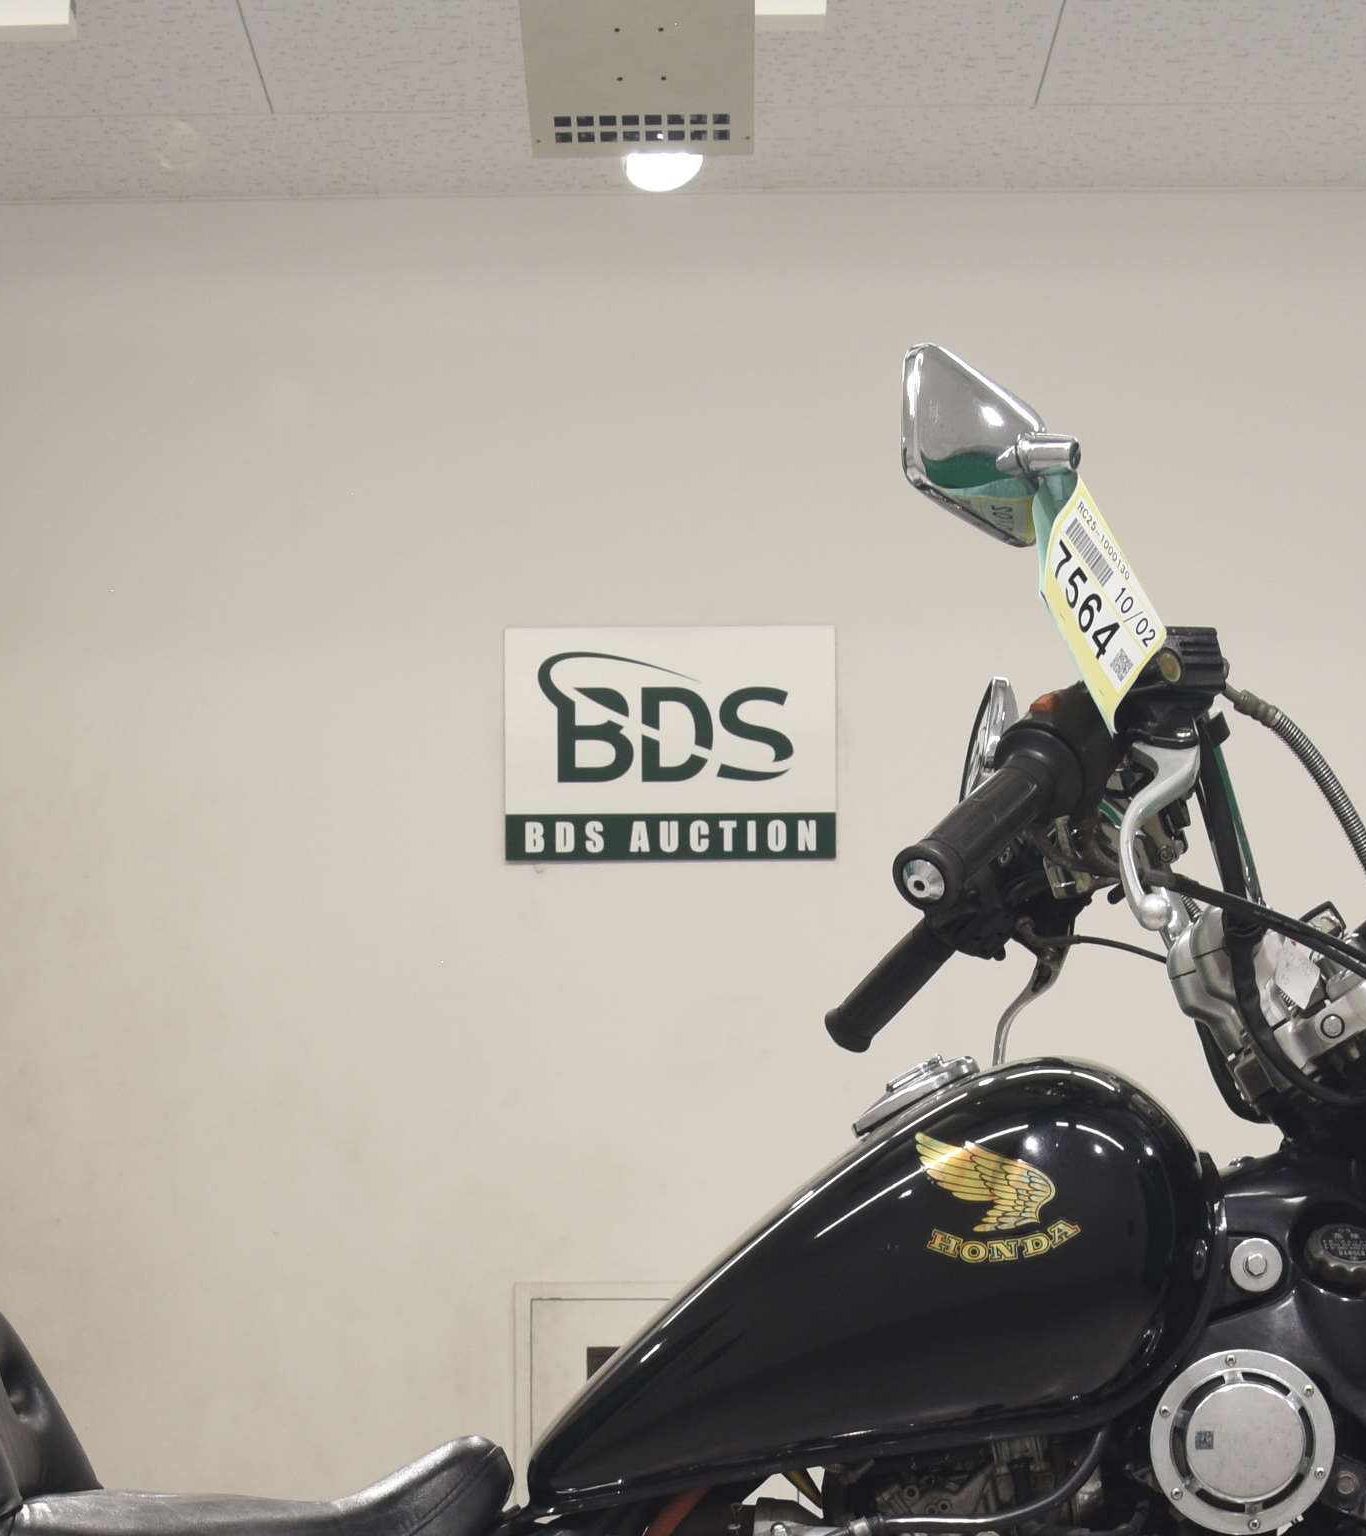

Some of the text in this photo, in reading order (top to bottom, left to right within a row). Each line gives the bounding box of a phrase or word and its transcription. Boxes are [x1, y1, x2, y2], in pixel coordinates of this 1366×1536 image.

[1054, 539, 1121, 660] 7564
[1114, 587, 1156, 648] 10/02
[537, 652, 794, 783] BDS
[525, 819, 817, 853] BDS AUCTION
[926, 1218, 1082, 1263] HONDA
